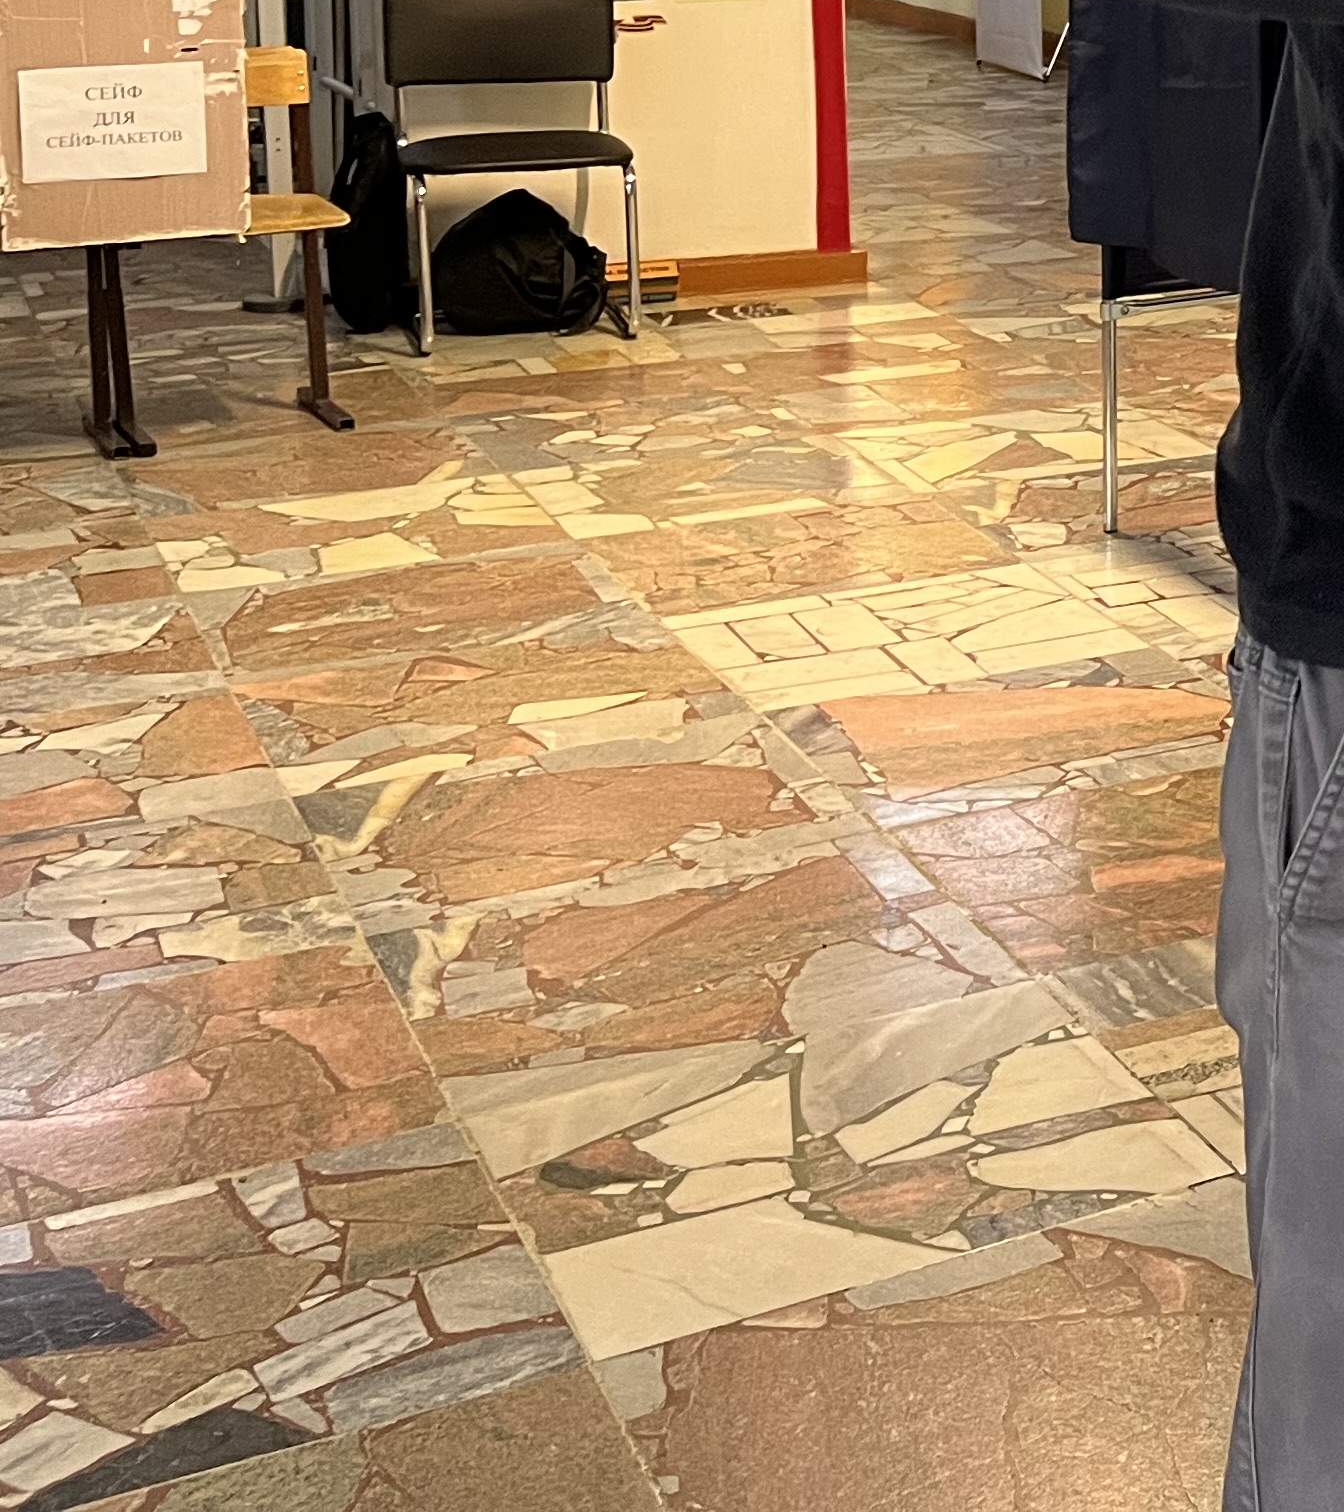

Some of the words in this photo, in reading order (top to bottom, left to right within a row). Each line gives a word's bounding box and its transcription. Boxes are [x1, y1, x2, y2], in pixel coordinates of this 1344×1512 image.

[85, 82, 143, 101] СЕЙФ
[92, 110, 135, 128] ДЛЯ
[46, 129, 183, 149] СЕЙФ-ПАКЕТОВ
